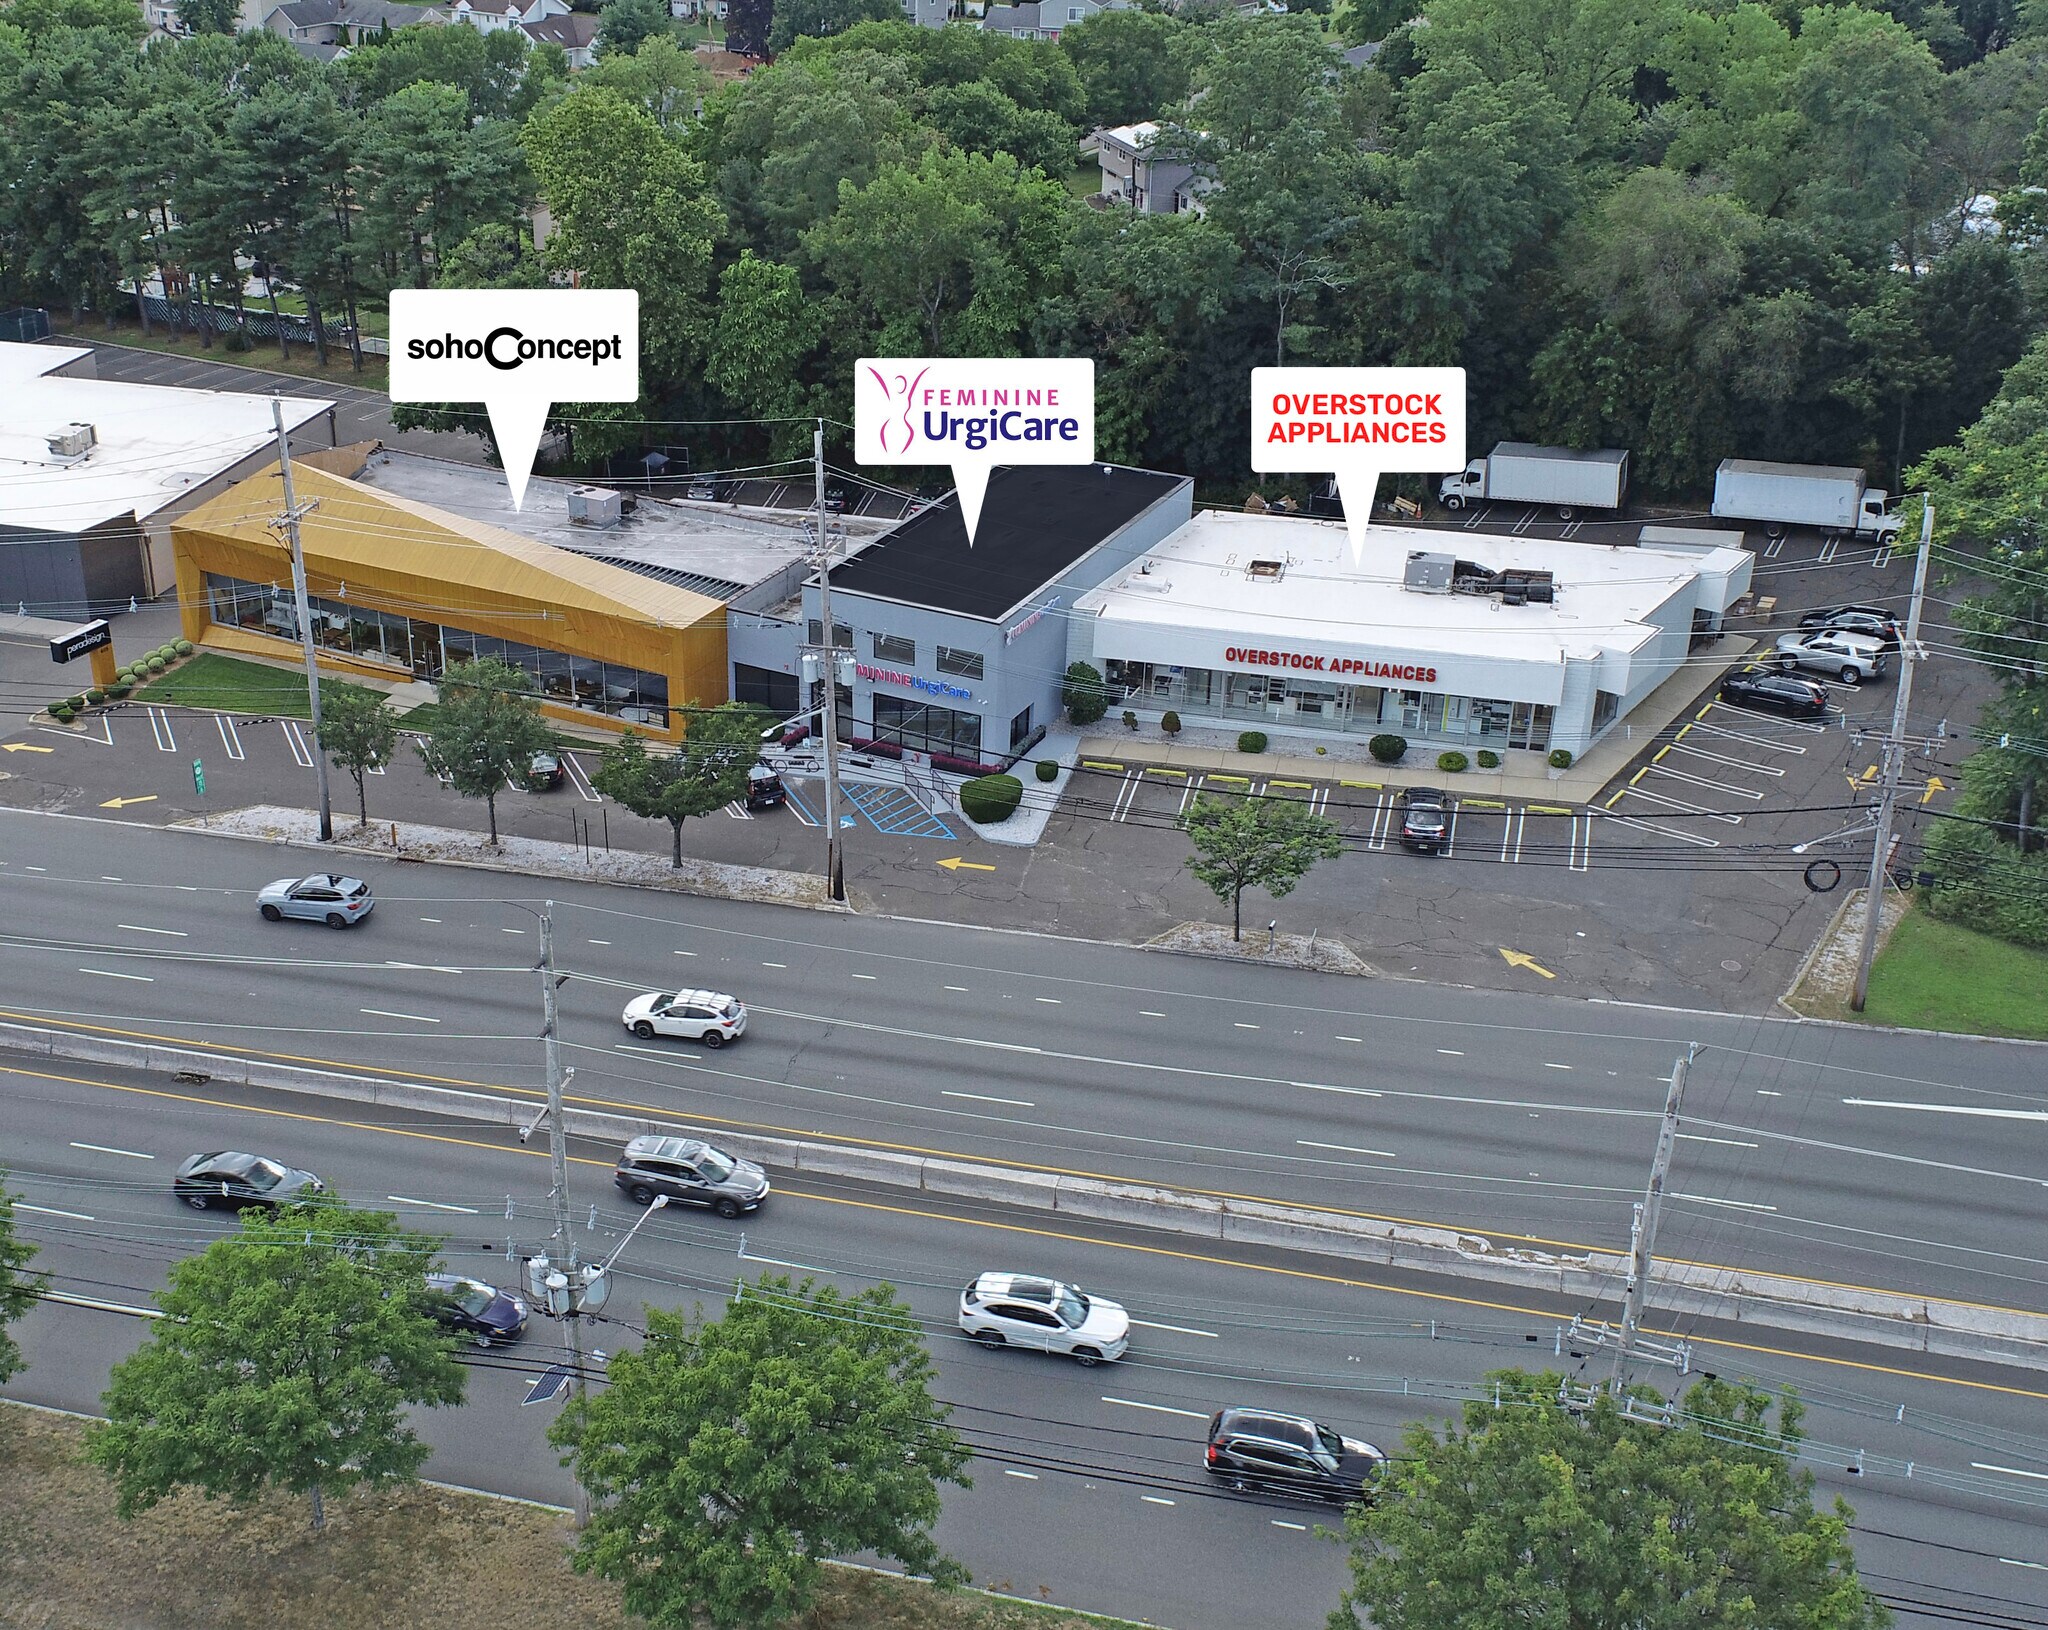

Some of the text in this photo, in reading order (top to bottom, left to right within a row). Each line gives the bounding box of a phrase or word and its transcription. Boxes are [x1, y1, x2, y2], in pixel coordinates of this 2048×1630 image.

[856, 664, 972, 699] MININE UrgiCare
[1225, 647, 1437, 682] OVERSTOCK APPLIANCES
